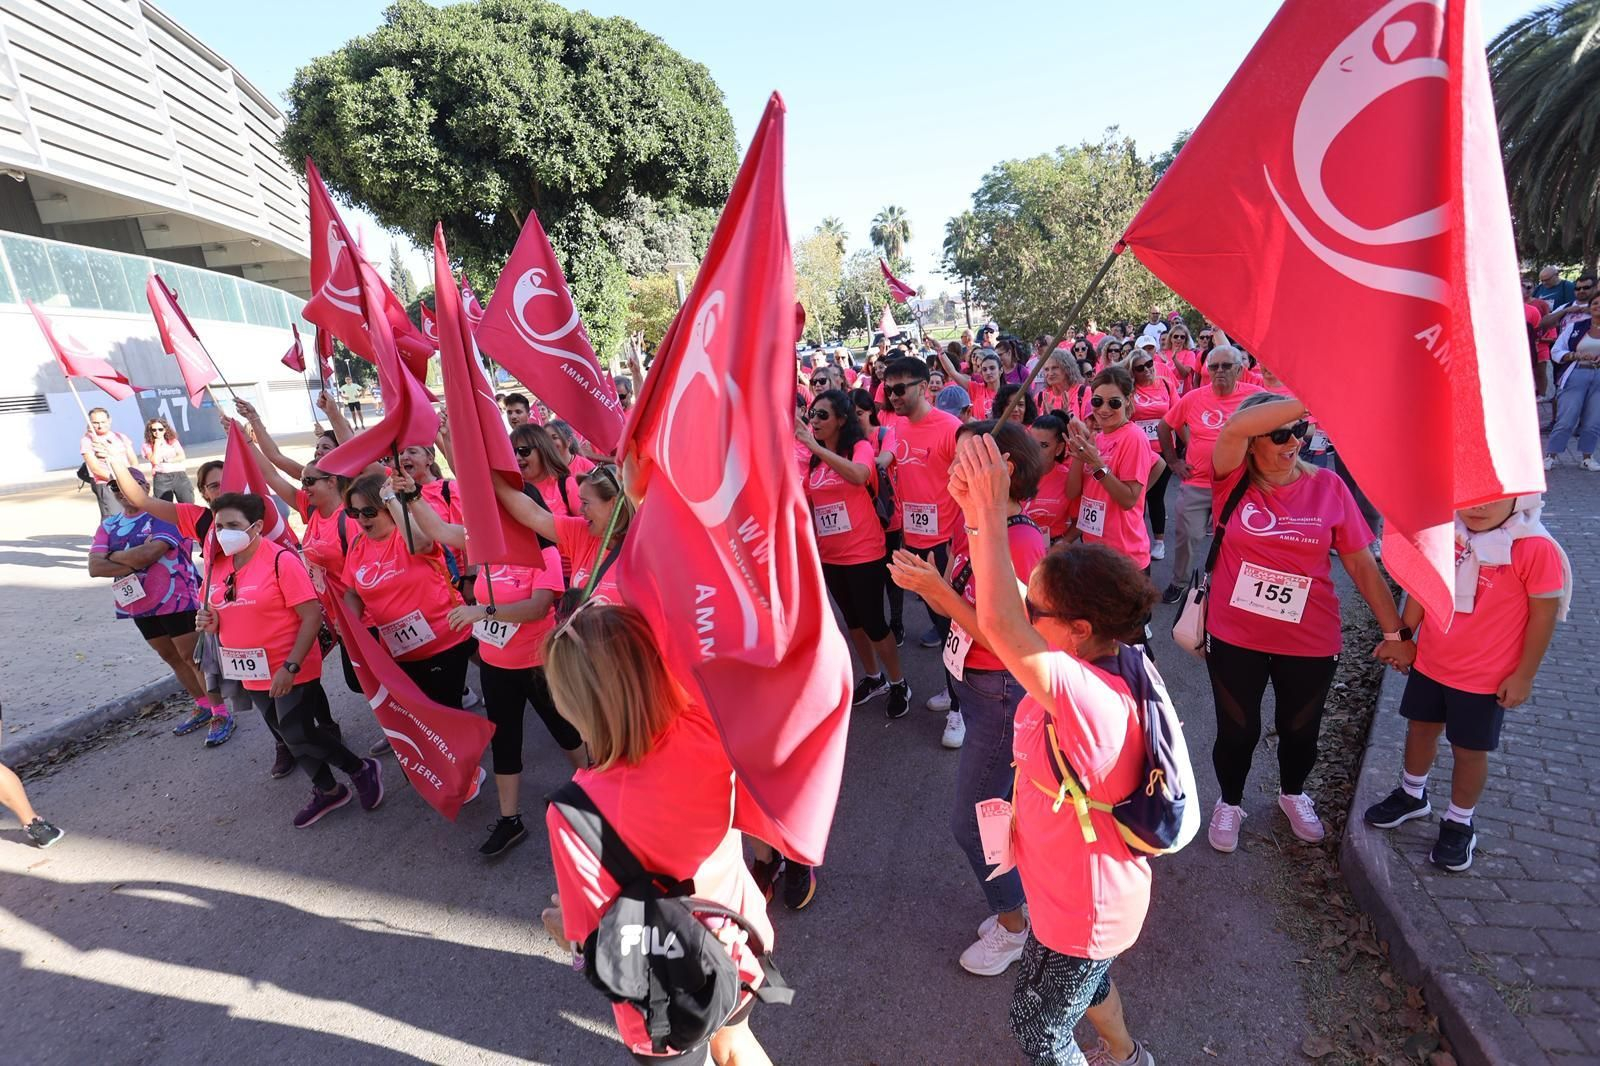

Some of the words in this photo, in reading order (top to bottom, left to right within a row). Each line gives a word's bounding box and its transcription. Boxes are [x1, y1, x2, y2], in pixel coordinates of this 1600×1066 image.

[560, 363, 590, 390] AMMA
[589, 387, 615, 412] JEREZ
[157, 396, 190, 433] 17
[820, 512, 838, 527] 117
[910, 512, 929, 526] 129
[1279, 534, 1300, 542] AMMA
[1301, 537, 1320, 545] JEREZ
[121, 584, 134, 597] 39
[1253, 580, 1294, 605] 155
[394, 624, 419, 644] 111
[482, 619, 508, 639] 101
[231, 658, 256, 671] 119
[410, 762, 443, 790] JEREZ
[620, 924, 685, 960] FILA
